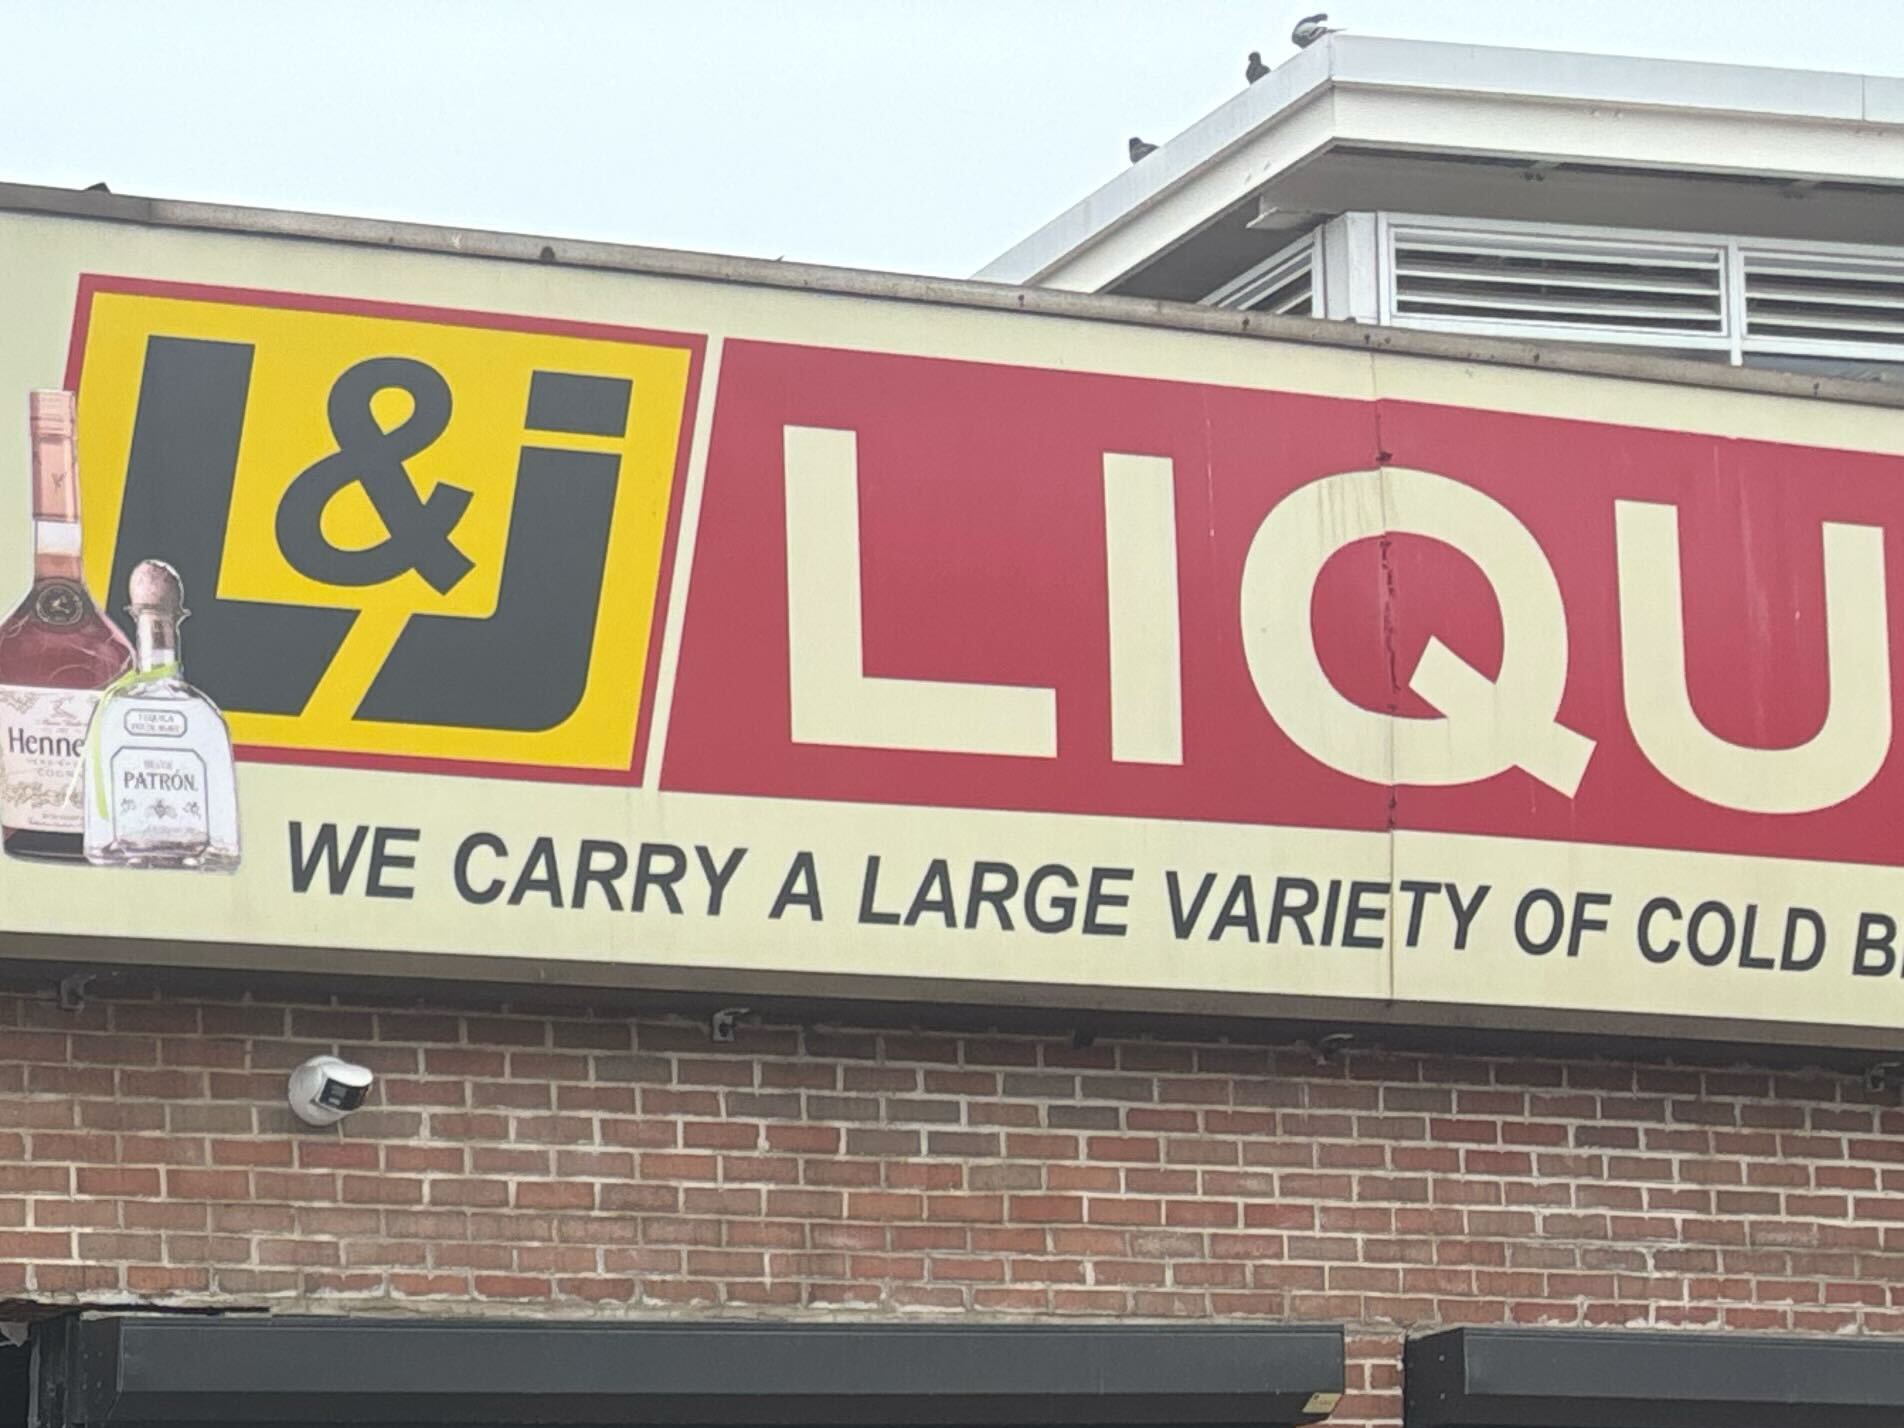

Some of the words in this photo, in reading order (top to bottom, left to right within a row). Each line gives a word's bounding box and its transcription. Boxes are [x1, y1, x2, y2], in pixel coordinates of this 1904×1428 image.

[781, 424, 1894, 814] LIQU
[287, 820, 421, 899] WE
[452, 831, 748, 916] CARRY
[768, 851, 824, 921] A
[857, 855, 1135, 937] LARGE
[1165, 870, 1492, 951] VARIETY
[1514, 887, 1612, 958] OF
[1637, 896, 1828, 972] COLD
[1852, 912, 1904, 980] B
